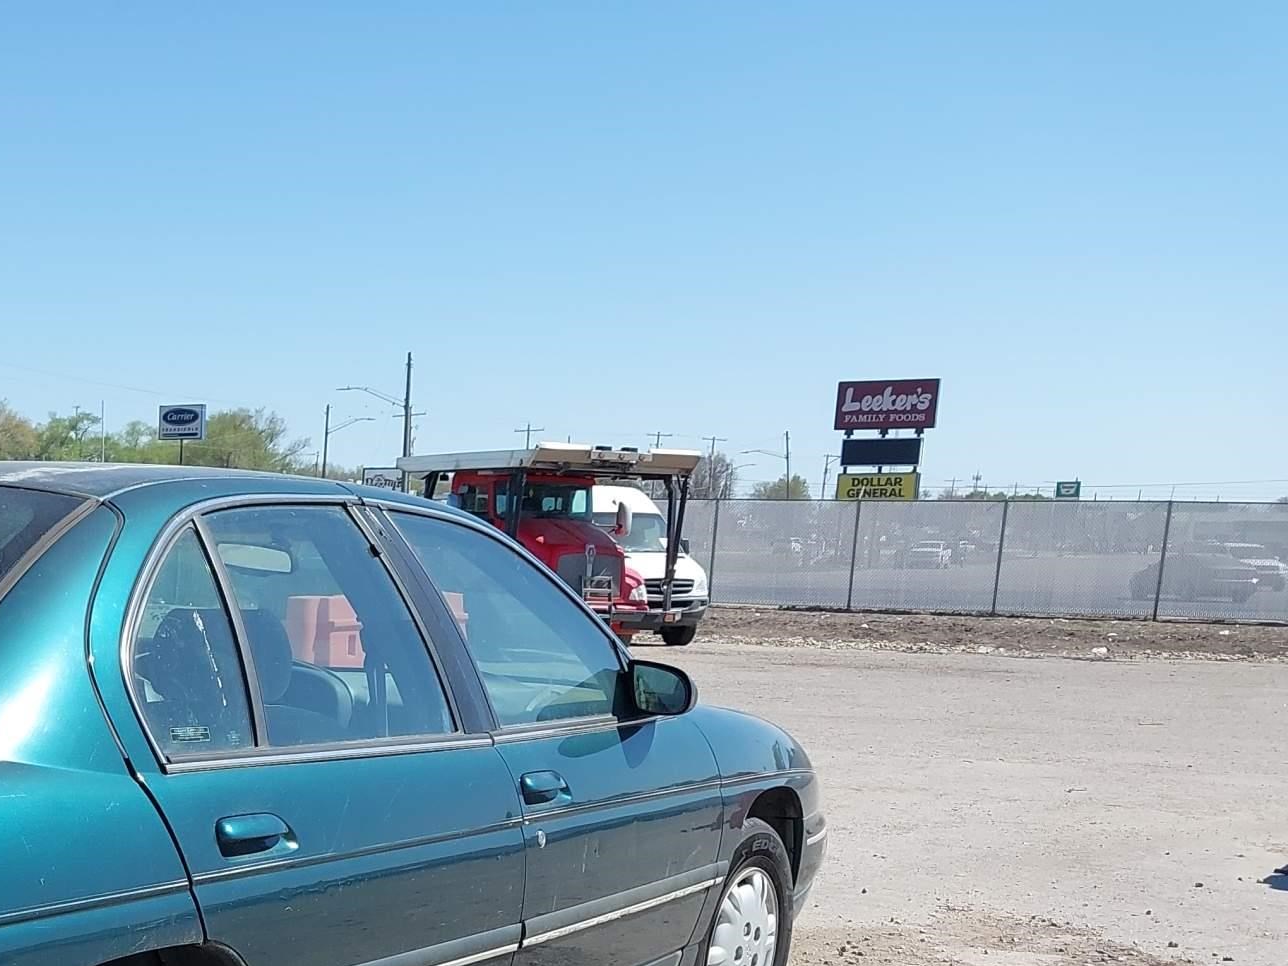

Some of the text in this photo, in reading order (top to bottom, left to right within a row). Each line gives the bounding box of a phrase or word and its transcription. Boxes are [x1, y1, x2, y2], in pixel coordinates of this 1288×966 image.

[841, 386, 932, 412] Leeker's
[167, 412, 195, 421] Carrier
[844, 413, 926, 423] FAMILY FOODS
[851, 477, 903, 487] DOLLAR
[846, 488, 905, 498] GENERAL
